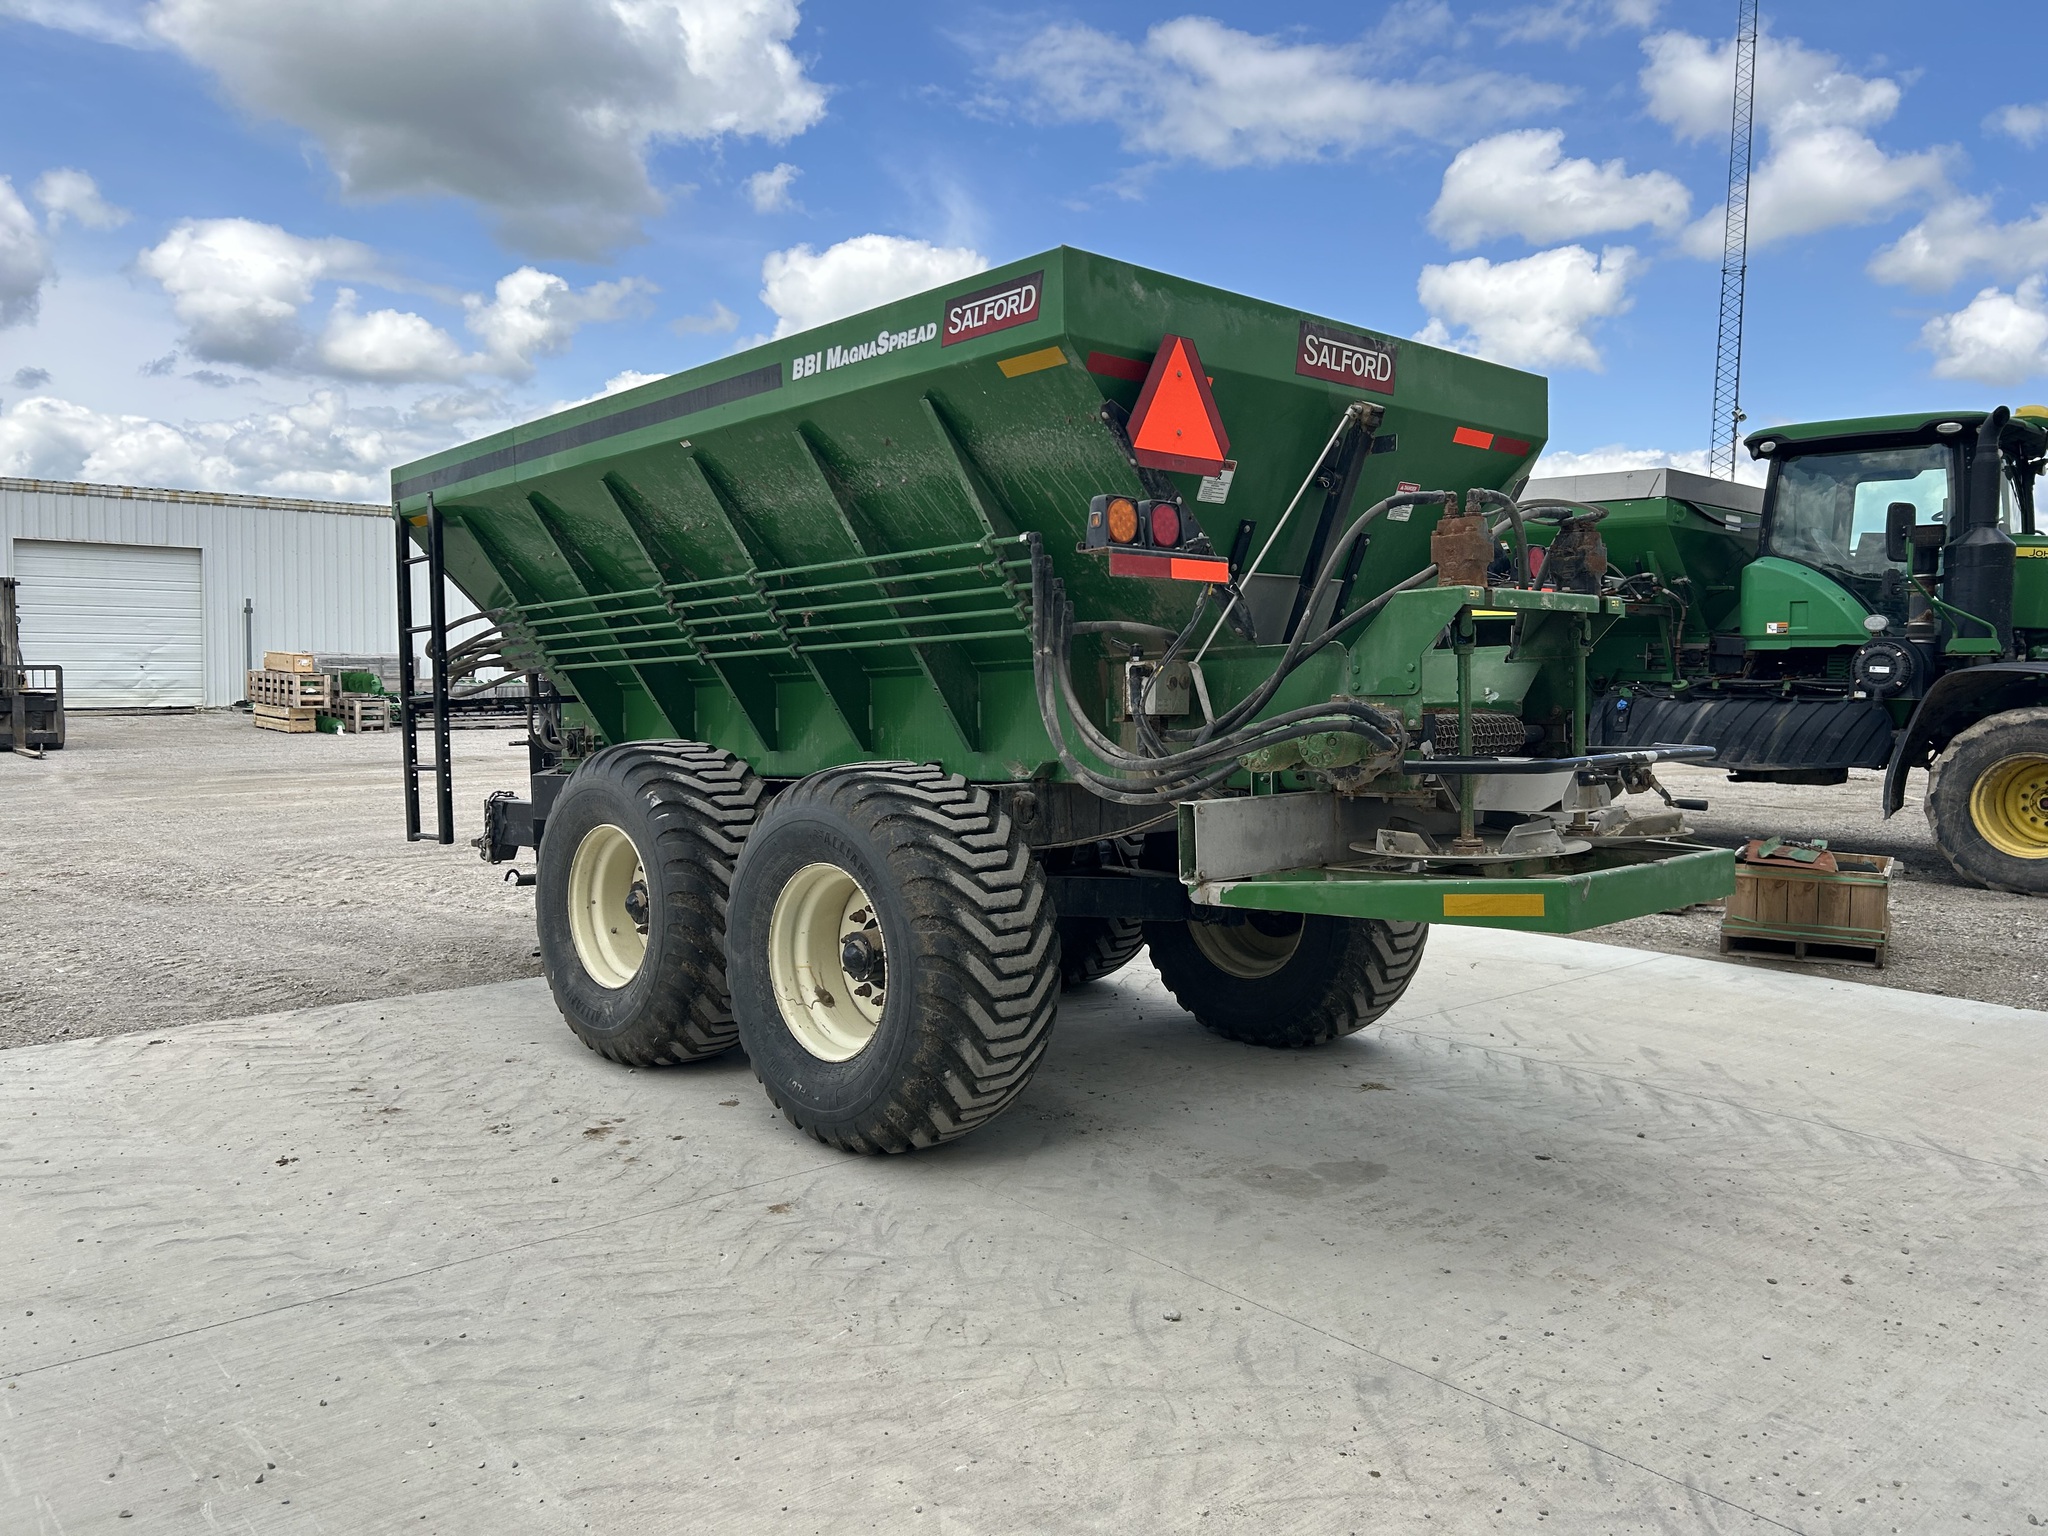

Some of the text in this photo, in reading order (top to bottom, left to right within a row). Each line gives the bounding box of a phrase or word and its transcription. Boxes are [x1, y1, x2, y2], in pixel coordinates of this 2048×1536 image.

[947, 284, 1037, 335] SALFORD
[792, 351, 822, 381] BBI
[1303, 334, 1392, 382] SALFORD
